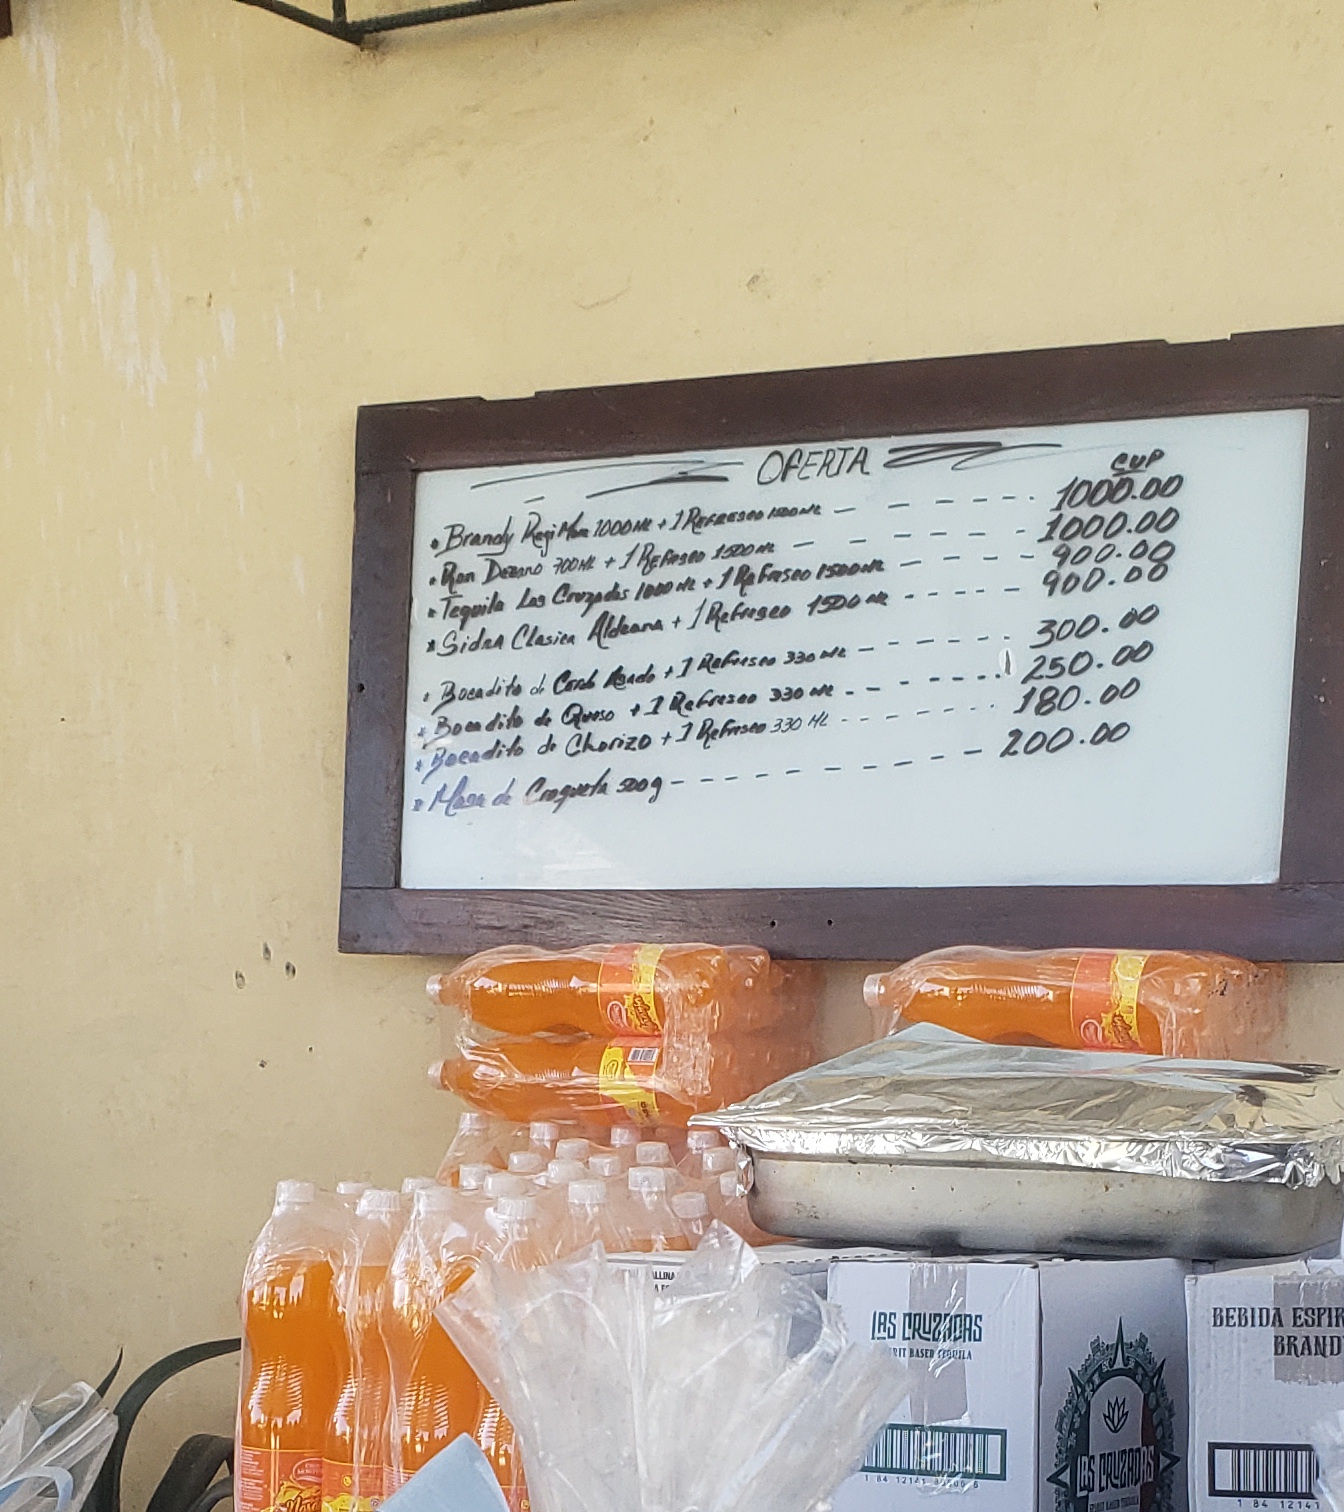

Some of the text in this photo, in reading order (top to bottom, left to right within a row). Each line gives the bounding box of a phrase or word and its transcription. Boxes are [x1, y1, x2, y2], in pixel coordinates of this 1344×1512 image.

[757, 446, 870, 485] OFERTA
[1111, 448, 1164, 472] CUP
[434, 515, 514, 557] Brandy
[1050, 474, 1183, 512] 1000.00
[441, 561, 475, 594] Ron
[1037, 507, 1180, 543] 1000.00
[437, 629, 504, 656] Sidra
[511, 623, 575, 650] Clasica
[587, 610, 663, 650] Aldeana
[1043, 563, 1168, 597] 900.00
[439, 591, 504, 631] Tequila
[1052, 539, 1176, 568] 900.00
[431, 674, 523, 716] Bocadito
[783, 650, 815, 665] 330
[1029, 604, 1160, 649] 300.00
[561, 702, 615, 730] Queso
[769, 686, 804, 702] 330
[1021, 640, 1154, 684] 250.00
[565, 731, 652, 757] Chorizo
[770, 717, 803, 734] 330
[1013, 677, 1141, 716] 180.00
[999, 722, 1130, 758] 200.00
[871, 1310, 983, 1343] LAS CRUZADAS
[1212, 1306, 1284, 1328] BEBIDA
[909, 1348, 935, 1359] BASED
[937, 1349, 973, 1361] TEQUILA
[1077, 1445, 1155, 1497] LAS CRUZADAS
[1253, 1500, 1268, 1508] 84
[1280, 1500, 1320, 1510] 12141
